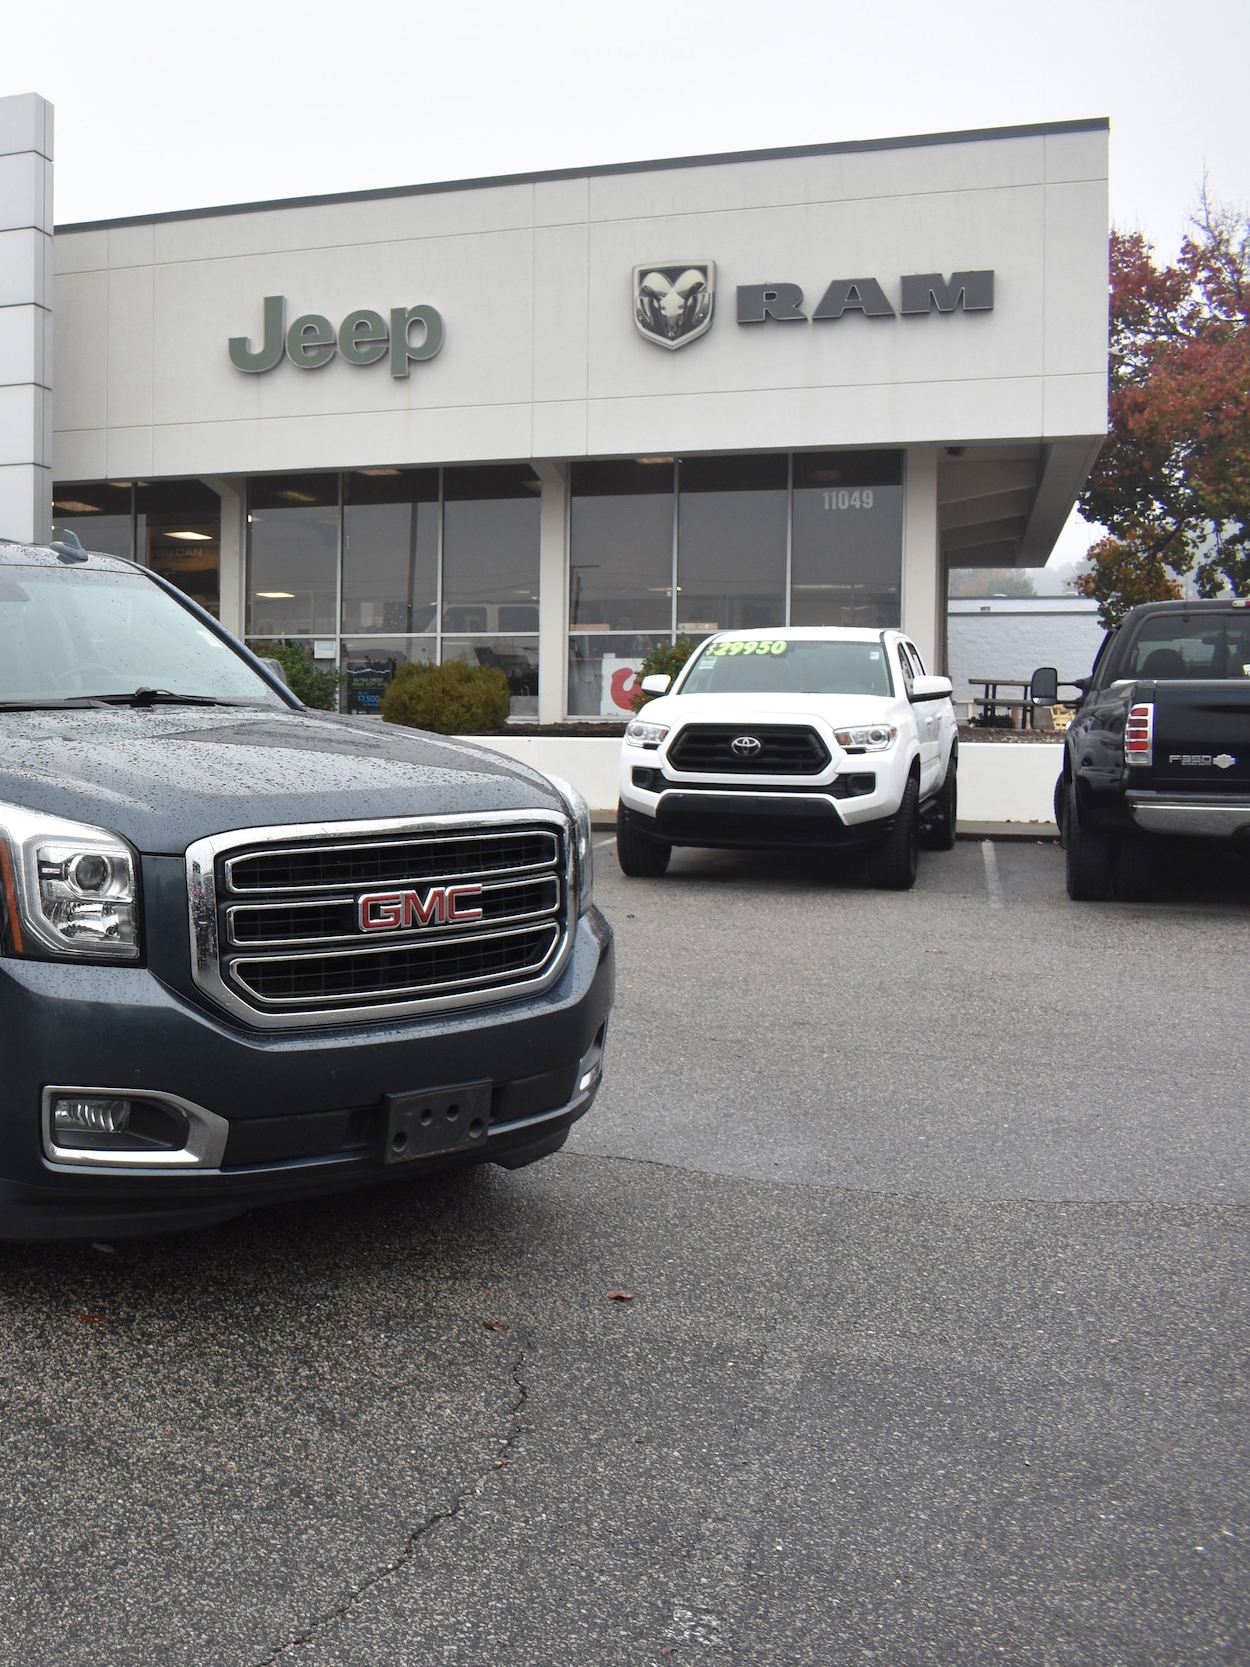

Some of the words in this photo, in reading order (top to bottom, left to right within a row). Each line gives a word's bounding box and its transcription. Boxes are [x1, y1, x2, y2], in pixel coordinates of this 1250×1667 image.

[736, 269, 996, 325] RAM
[227, 295, 446, 378] Jeep
[822, 489, 874, 510] 11049
[706, 640, 788, 656] $29950
[358, 883, 484, 932] GMC
